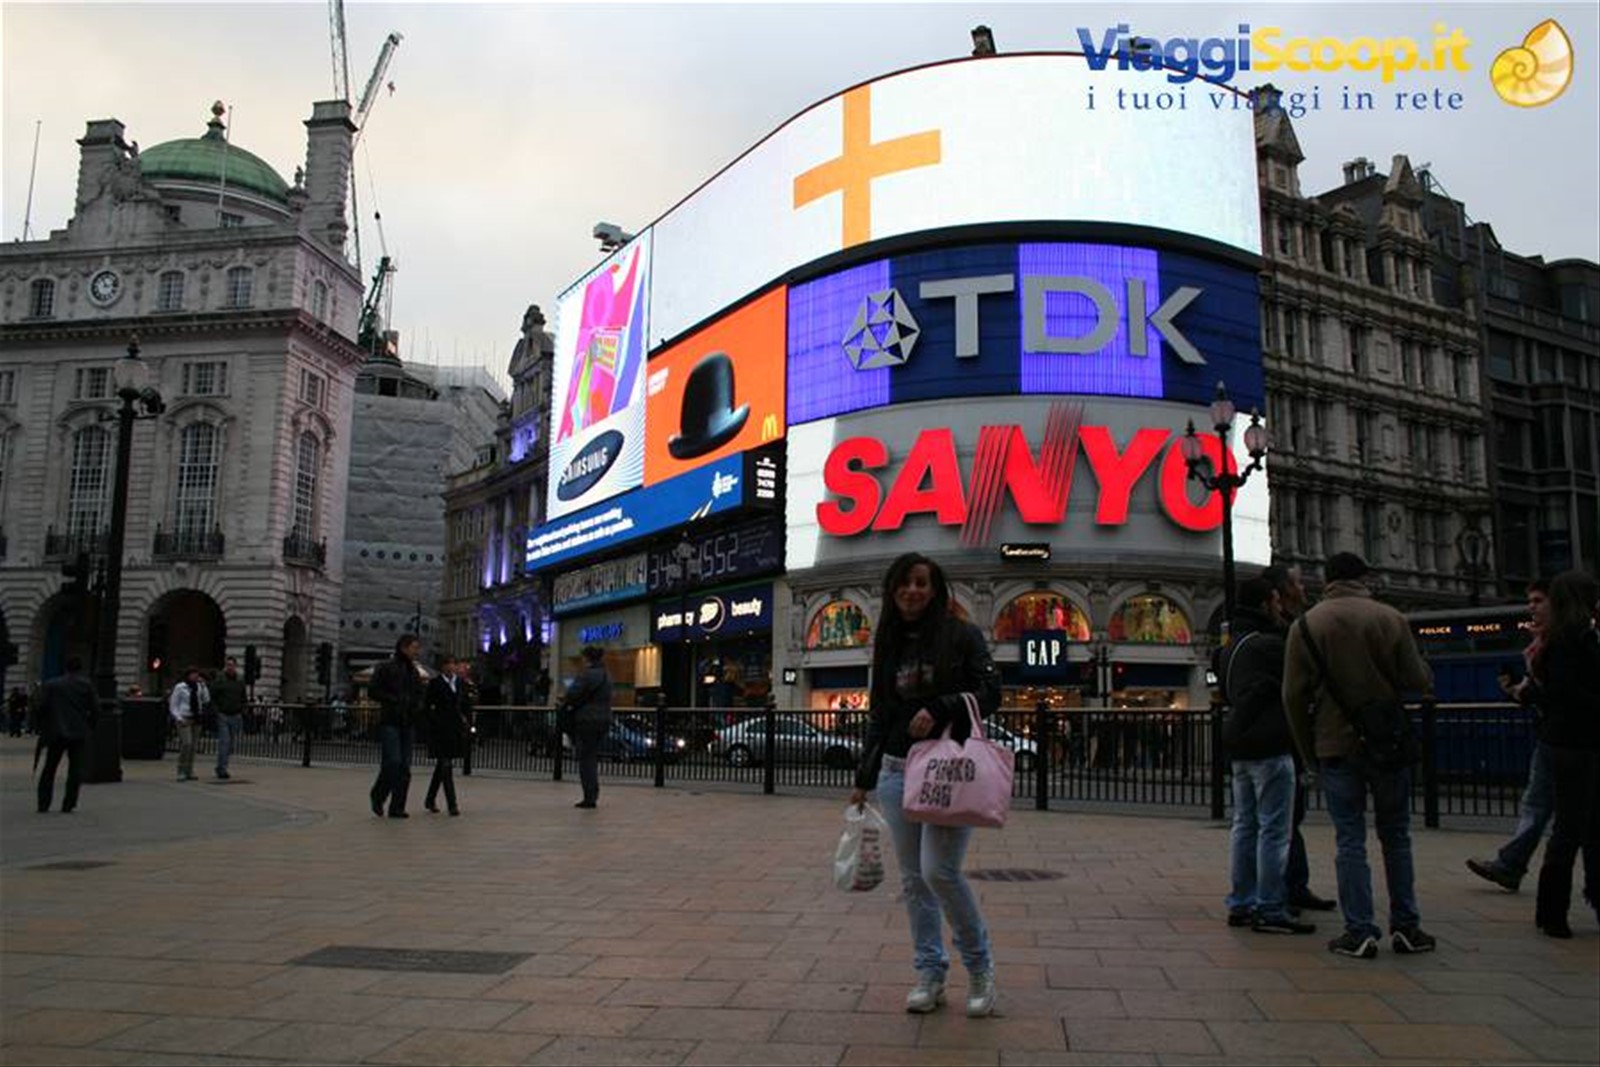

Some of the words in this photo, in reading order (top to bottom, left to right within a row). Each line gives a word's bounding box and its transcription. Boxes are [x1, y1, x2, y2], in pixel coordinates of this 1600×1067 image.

[919, 274, 1207, 364] TDK
[560, 446, 609, 486] SAMSUNG
[816, 401, 1237, 547] SANYO
[1419, 626, 1451, 635] POLICE
[1466, 623, 1501, 632] POLICE
[1027, 639, 1060, 666] GAP
[919, 782, 952, 808] BAG
